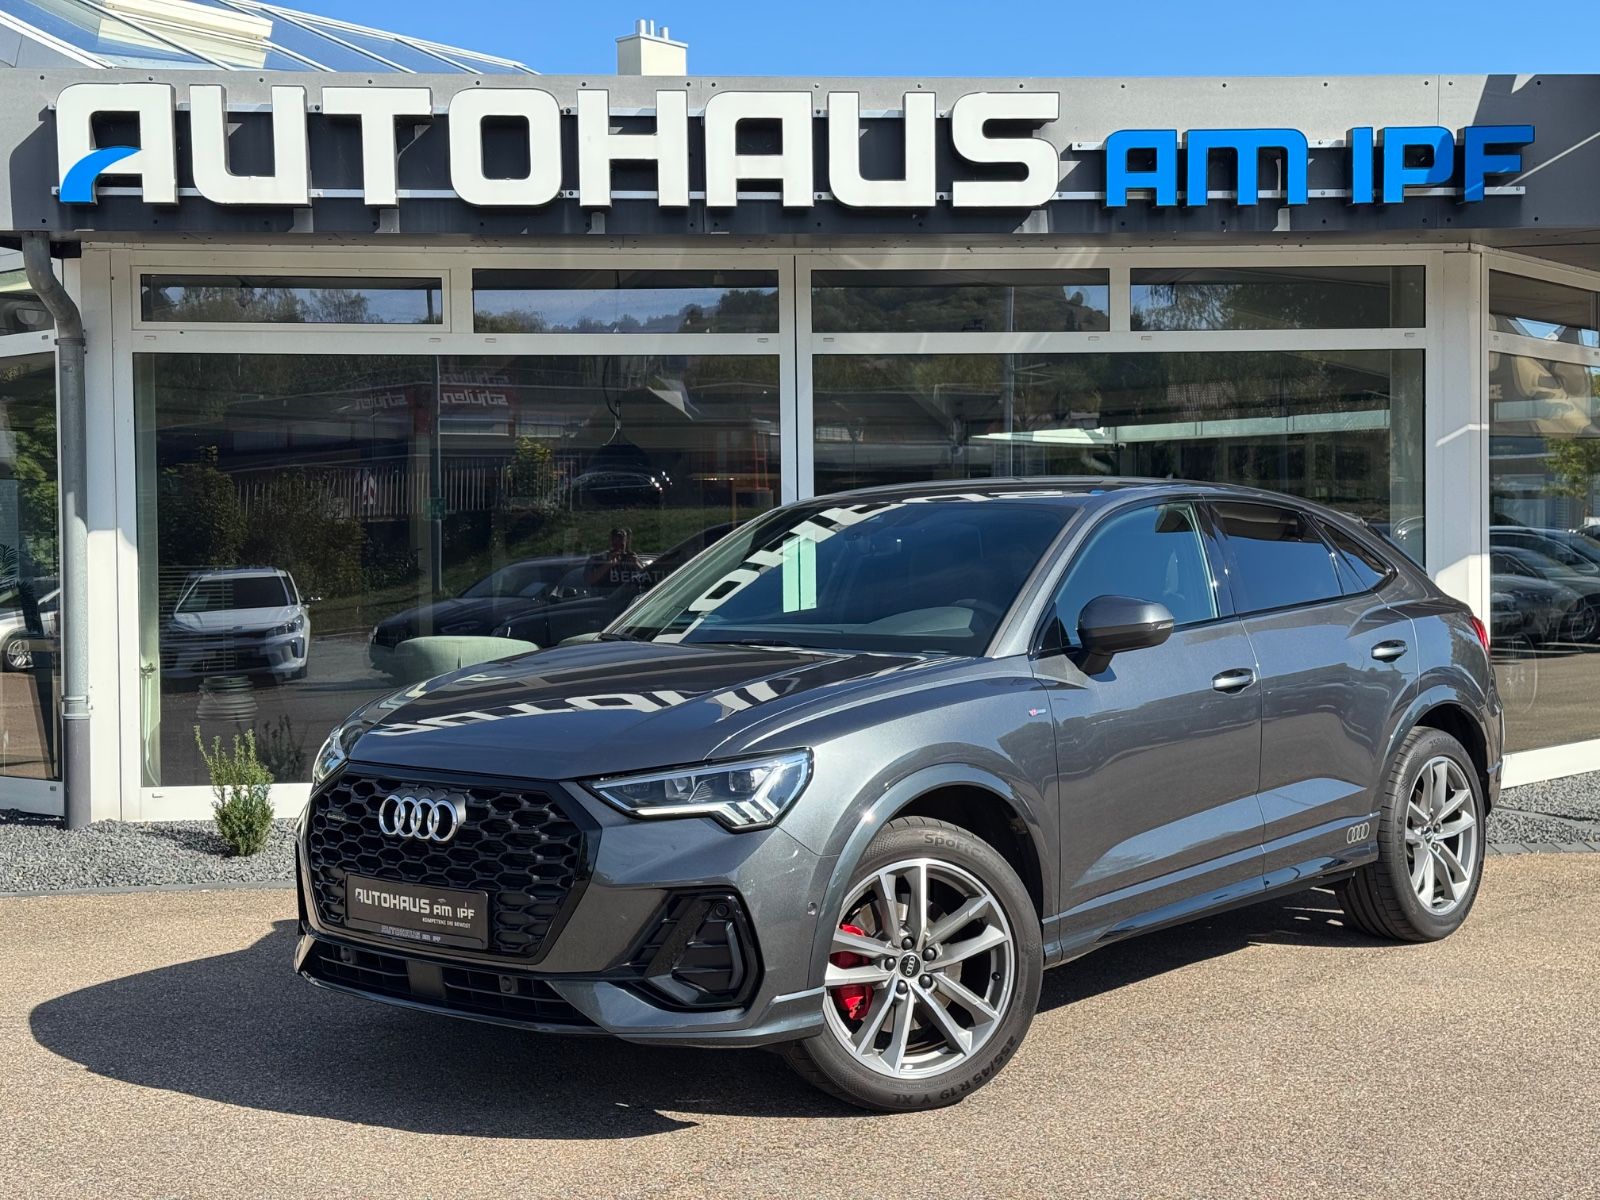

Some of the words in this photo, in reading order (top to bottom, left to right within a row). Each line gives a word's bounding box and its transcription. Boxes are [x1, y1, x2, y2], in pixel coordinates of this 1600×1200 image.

[56, 82, 1060, 208] AUTOHAUS
[1105, 128, 1309, 208] AM
[1346, 125, 1536, 206] IPF
[355, 887, 430, 914] AUTOHAUS
[433, 904, 453, 917] AM
[456, 907, 475, 920] IPF
[940, 1086, 958, 1101] 19
